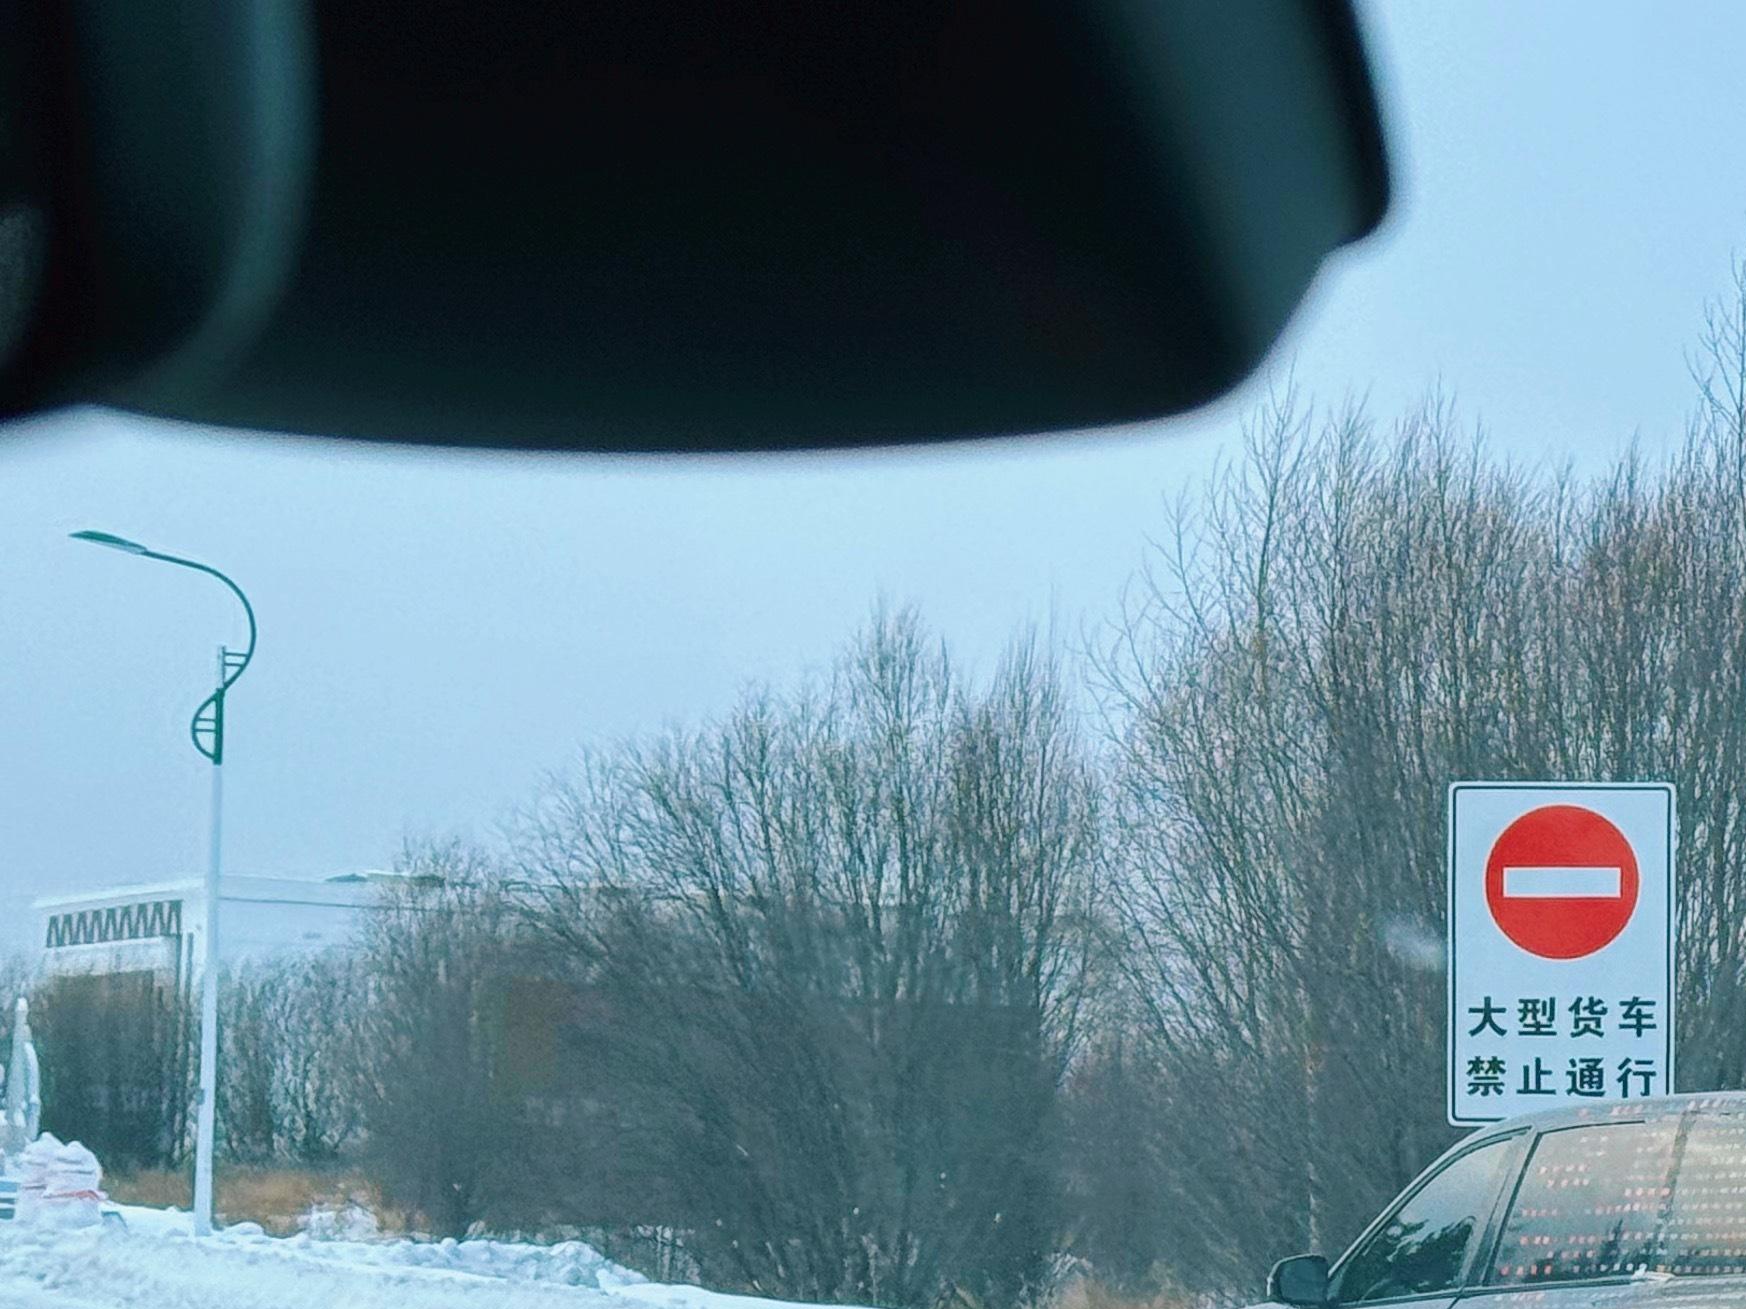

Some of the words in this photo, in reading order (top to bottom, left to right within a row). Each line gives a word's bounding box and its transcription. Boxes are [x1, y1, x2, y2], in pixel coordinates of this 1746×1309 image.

[1467, 995, 1657, 1038] 大型货车
[1465, 1055, 1657, 1098] 禁止通行
